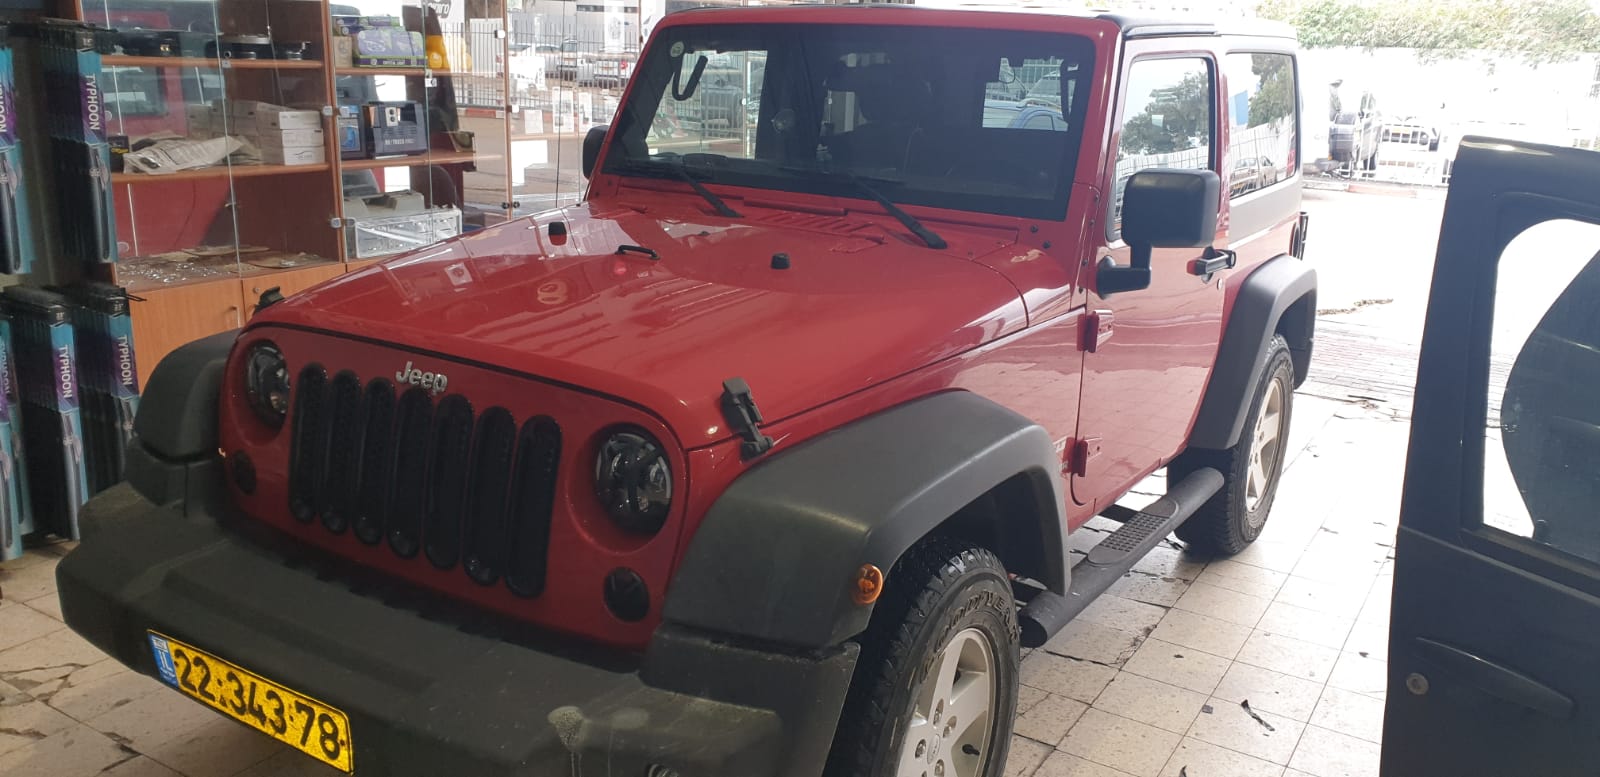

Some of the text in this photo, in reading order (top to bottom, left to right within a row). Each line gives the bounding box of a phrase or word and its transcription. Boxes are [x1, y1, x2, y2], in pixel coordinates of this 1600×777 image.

[86, 73, 100, 130] TYPHOON
[59, 344, 72, 399] TYPHOON
[117, 334, 133, 386] TYPHOON
[395, 361, 448, 396] Jeep
